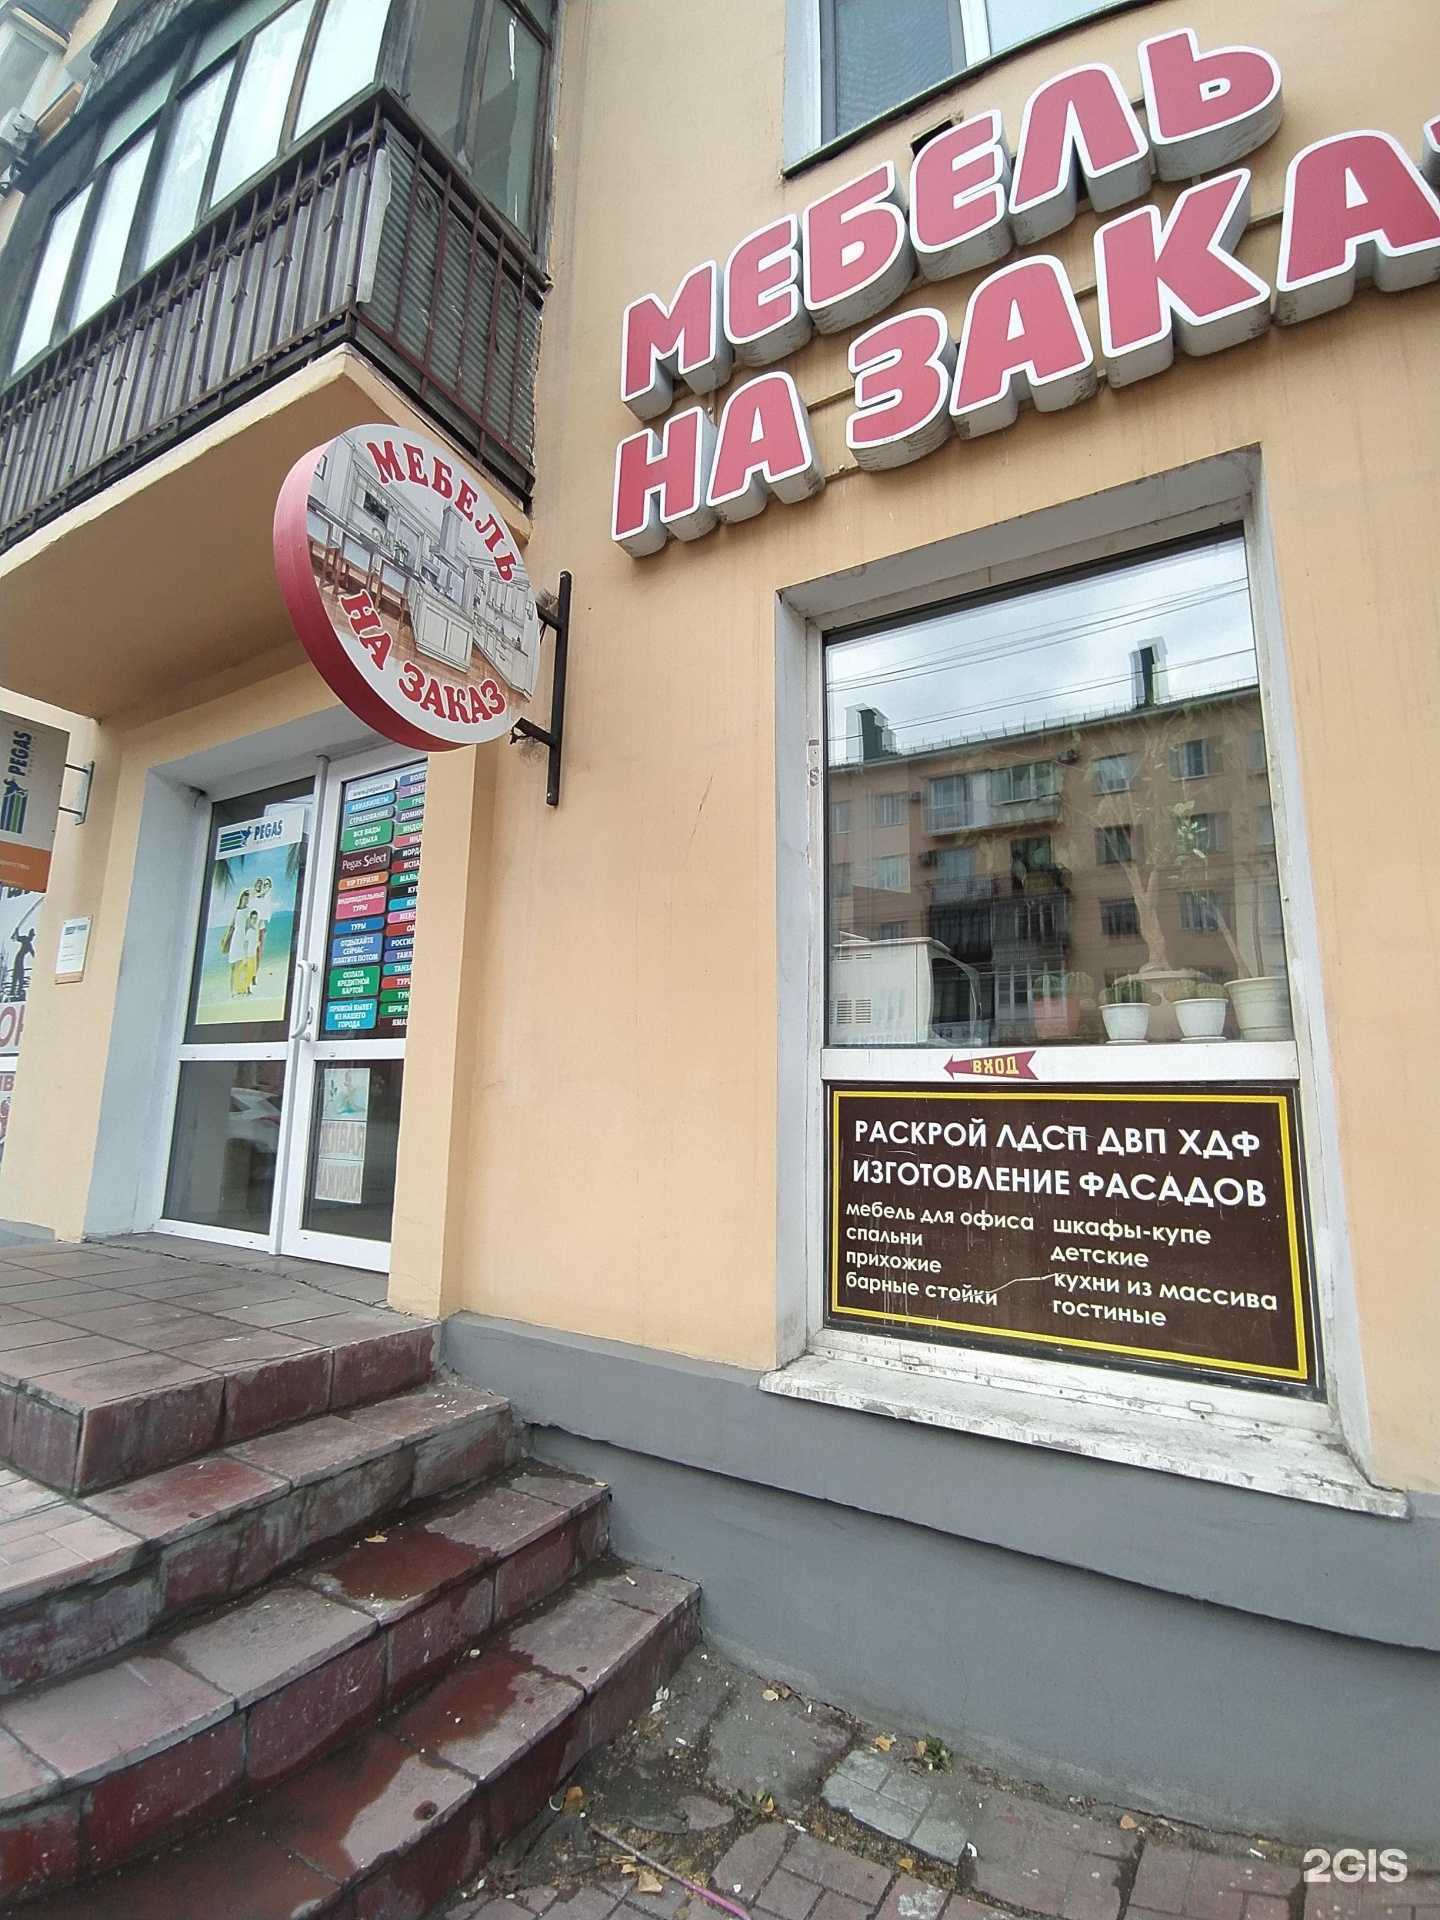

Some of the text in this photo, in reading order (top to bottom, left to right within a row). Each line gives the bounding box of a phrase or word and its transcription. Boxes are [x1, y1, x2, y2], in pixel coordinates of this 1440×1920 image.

[621, 27, 1283, 403] МЕБЕЛЬ
[611, 116, 1440, 542] НА ЗАКА
[366, 440, 518, 583] МЕБЕЛЬ
[339, 589, 506, 724] НА ЗАКАЗ
[8, 731, 32, 776] PEGAS
[253, 819, 283, 840] PEGAS
[342, 852, 387, 870] Pegas Select
[351, 922, 367, 931] ТУРЫ
[972, 1055, 1019, 1075] ВХОД
[855, 1118, 1261, 1160] РАСКРОЙ ЛДСП ДВП ХДФ
[852, 1160, 1267, 1208] ИЗГОТОВЛЕНИЕ ФАСАДОВ
[846, 1202, 1035, 1231] мебель для офиса
[845, 1227, 923, 1247] спальни
[1053, 1219, 1212, 1248] шкафы-купе
[845, 1250, 942, 1274] прихожие
[1050, 1244, 1150, 1269] детские
[845, 1272, 998, 1307] барные стойки
[1054, 1273, 1278, 1312] кухни из массива
[1052, 1300, 1167, 1328] гостиные
